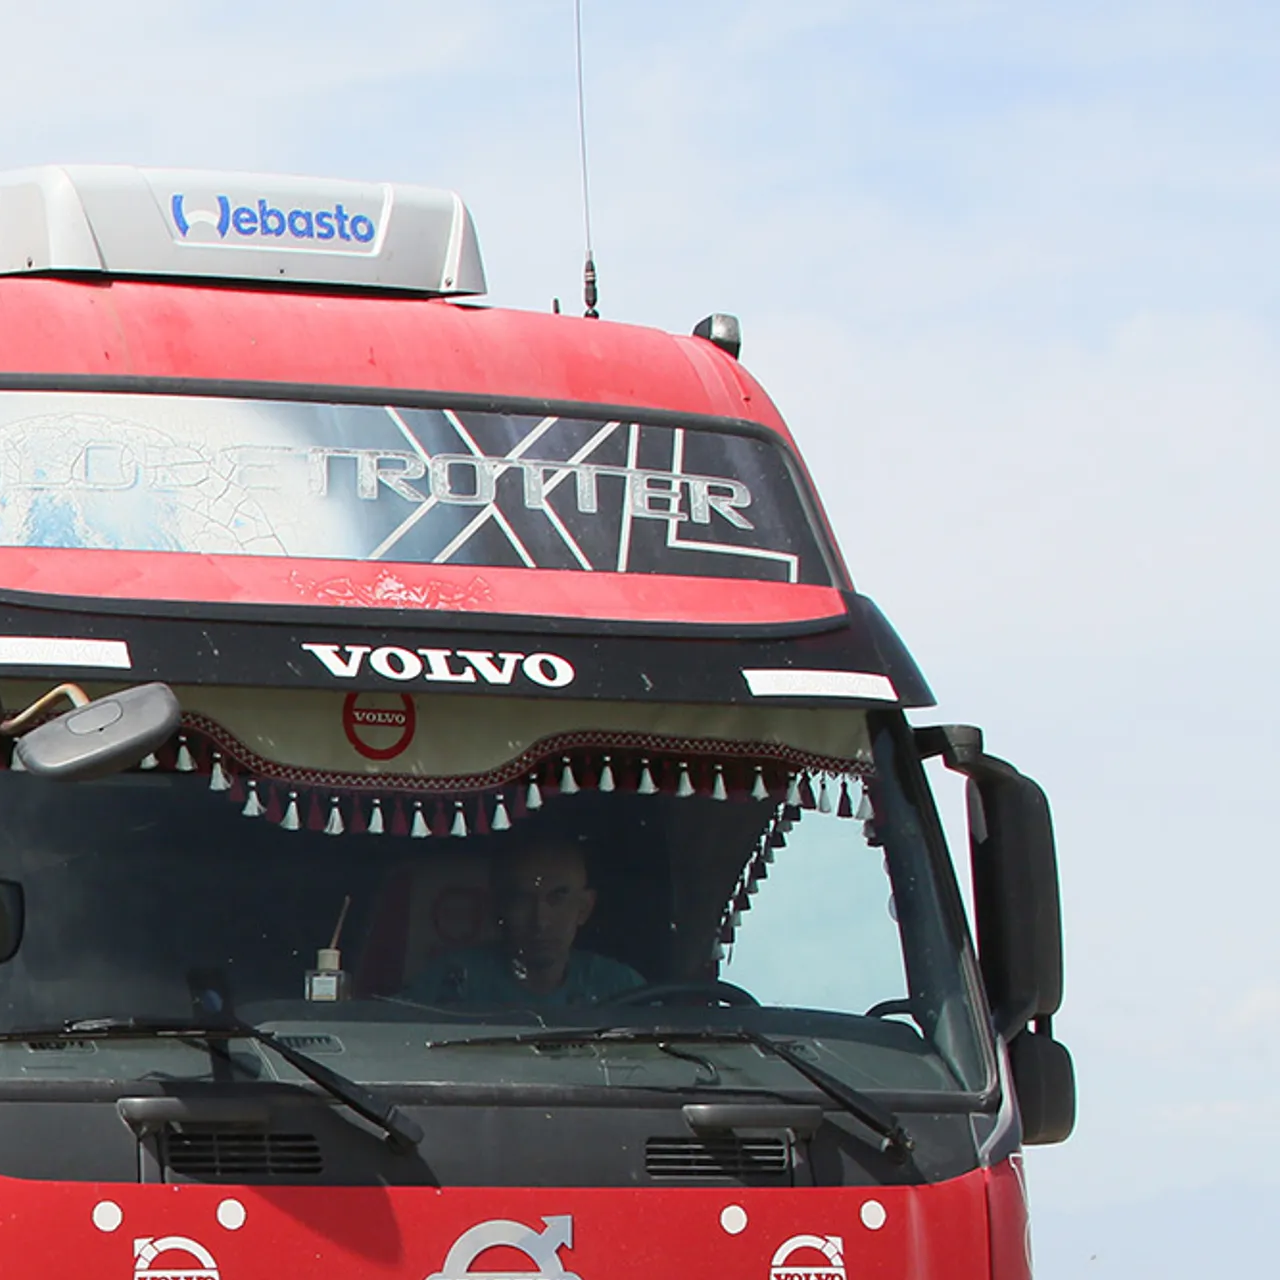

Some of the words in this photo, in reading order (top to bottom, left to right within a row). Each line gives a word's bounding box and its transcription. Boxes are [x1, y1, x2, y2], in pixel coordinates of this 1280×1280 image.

[171, 194, 376, 243] Webasto
[300, 643, 576, 688] VOLVO
[352, 710, 406, 726] VOLVO
